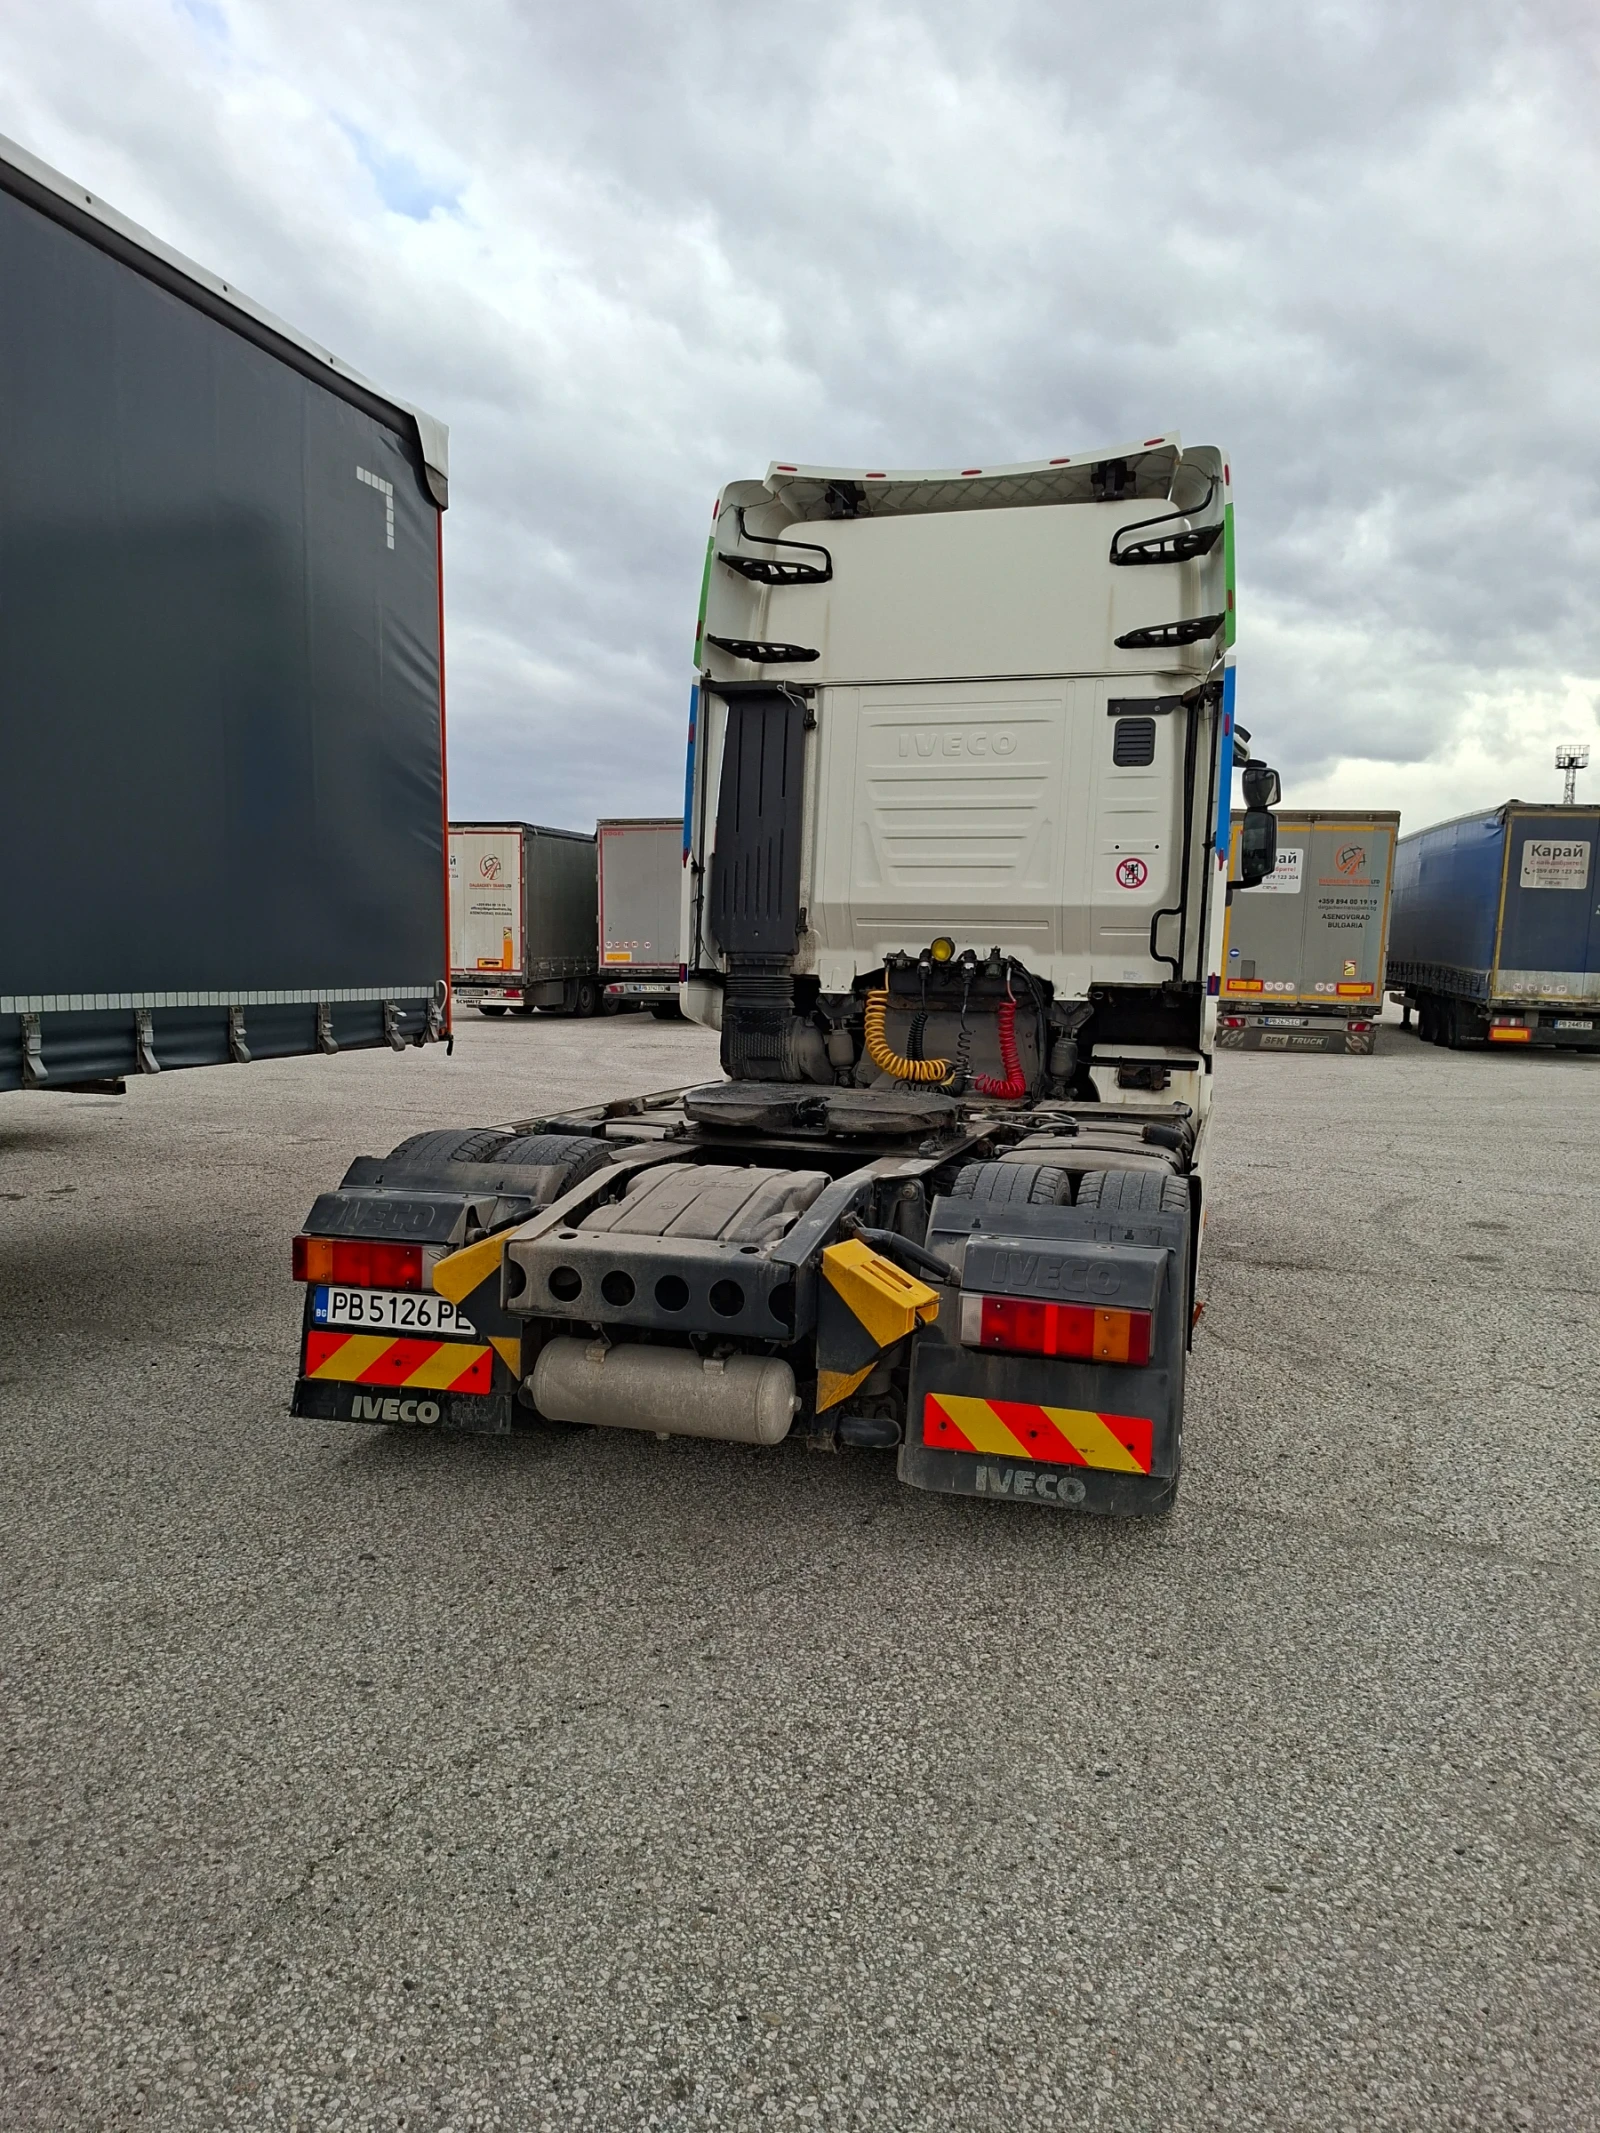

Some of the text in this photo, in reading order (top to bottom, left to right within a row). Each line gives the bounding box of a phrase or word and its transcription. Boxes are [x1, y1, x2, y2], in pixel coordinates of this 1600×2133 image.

[898, 731, 1018, 757] IVECO
[1531, 844, 1584, 860] Карай
[1321, 913, 1371, 921] ASENOVGRAD
[1327, 921, 1364, 929] BULGARIA
[1264, 1036, 1325, 1046] SFK TRUCK
[334, 1201, 436, 1233] IVECO
[991, 1252, 1121, 1295] IVECO
[316, 1308, 327, 1318] BG
[351, 1395, 440, 1424] IVECO
[975, 1465, 1086, 1503] IVECO
